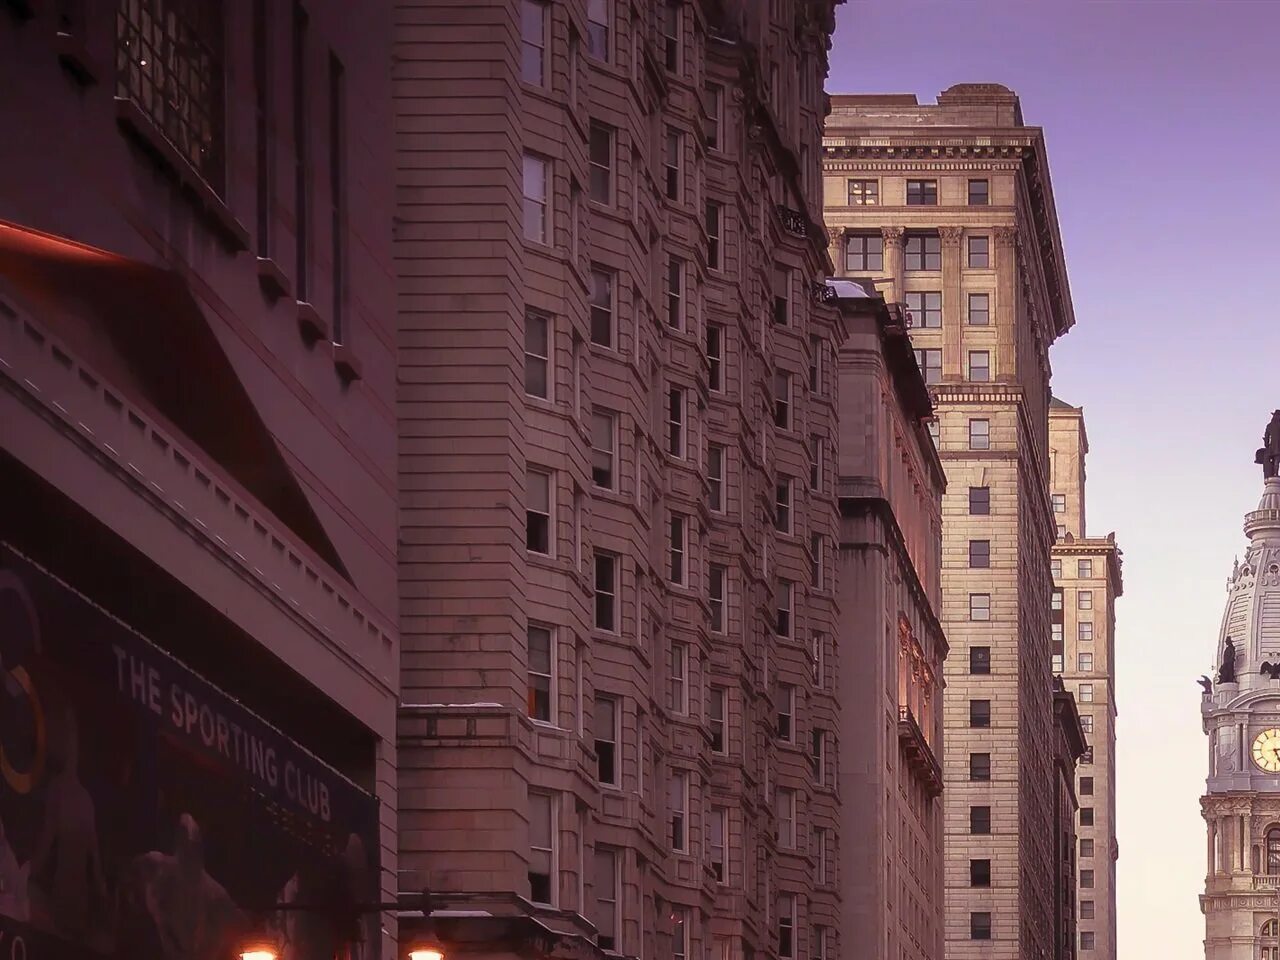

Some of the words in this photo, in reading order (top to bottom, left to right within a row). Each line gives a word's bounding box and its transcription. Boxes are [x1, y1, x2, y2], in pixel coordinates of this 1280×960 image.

[112, 643, 162, 716] THE
[171, 683, 278, 788] SPORTING
[284, 760, 332, 822] CLUB
